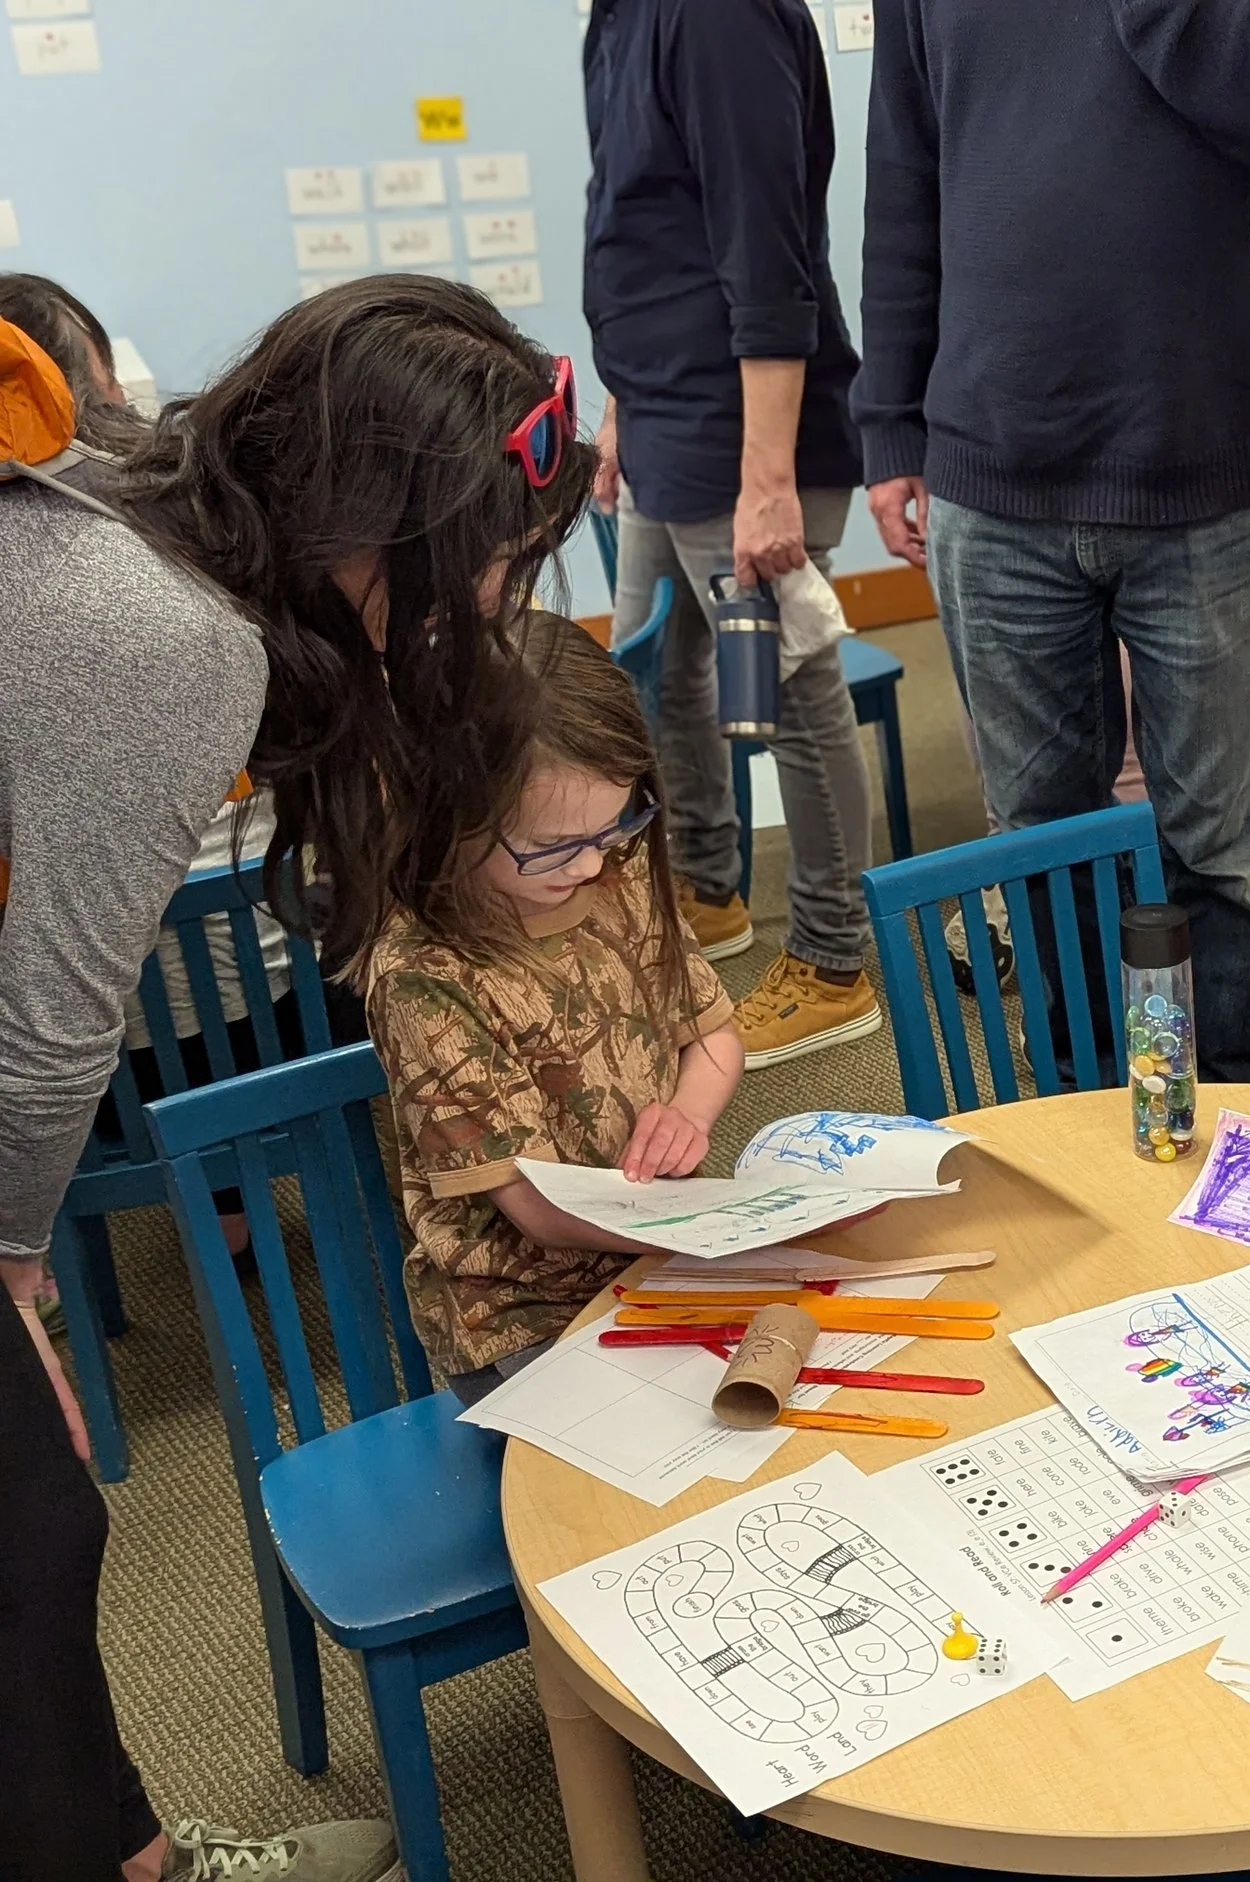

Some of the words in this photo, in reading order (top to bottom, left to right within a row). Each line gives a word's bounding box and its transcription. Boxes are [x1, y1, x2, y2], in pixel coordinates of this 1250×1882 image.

[1060, 1413, 1088, 1439] brave
[1039, 1428, 1058, 1445] kite
[1013, 1438, 1032, 1455] fine
[986, 1448, 1006, 1466] fate
[1068, 1456, 1091, 1475] rode
[1040, 1465, 1065, 1486] cone
[1015, 1477, 1037, 1497] here
[1122, 1472, 1154, 1499] grime
[1211, 1481, 1239, 1506] pose
[1101, 1488, 1121, 1505] eve
[1074, 1498, 1099, 1518] joke
[1185, 1496, 1210, 1517] date
[752, 1512, 767, 1525] what
[1046, 1509, 1068, 1529] bike
[740, 1532, 757, 1545] want
[1099, 1524, 1134, 1556] spere
[1216, 1525, 1250, 1553] phone
[655, 1549, 673, 1565] put
[869, 1554, 885, 1567] what
[958, 1545, 984, 1567] Read
[1194, 1541, 1216, 1561] wise
[1163, 1548, 1193, 1576] whale
[634, 1574, 649, 1585] out
[774, 1566, 791, 1580] says
[976, 1565, 998, 1582] and
[1138, 1562, 1163, 1584] drive
[906, 1579, 925, 1598] play
[990, 1580, 1011, 1597] Roll
[1016, 1582, 1037, 1602] Lesson
[1108, 1572, 1137, 1599] brake
[684, 1596, 702, 1613] finish
[731, 1595, 750, 1613] goes
[1200, 1584, 1227, 1610] wake
[789, 1605, 805, 1620] down
[1171, 1595, 1201, 1623] broke
[644, 1614, 659, 1630] from
[1142, 1606, 1174, 1636] theme
[673, 1650, 689, 1667] have
[813, 1643, 831, 1657] want
[782, 1670, 799, 1682] out
[703, 1685, 719, 1700] down
[858, 1678, 875, 1694] they
[809, 1709, 827, 1724] play
[826, 1730, 857, 1757] Land
[793, 1743, 827, 1774] Word
[764, 1758, 799, 1788] Heart
